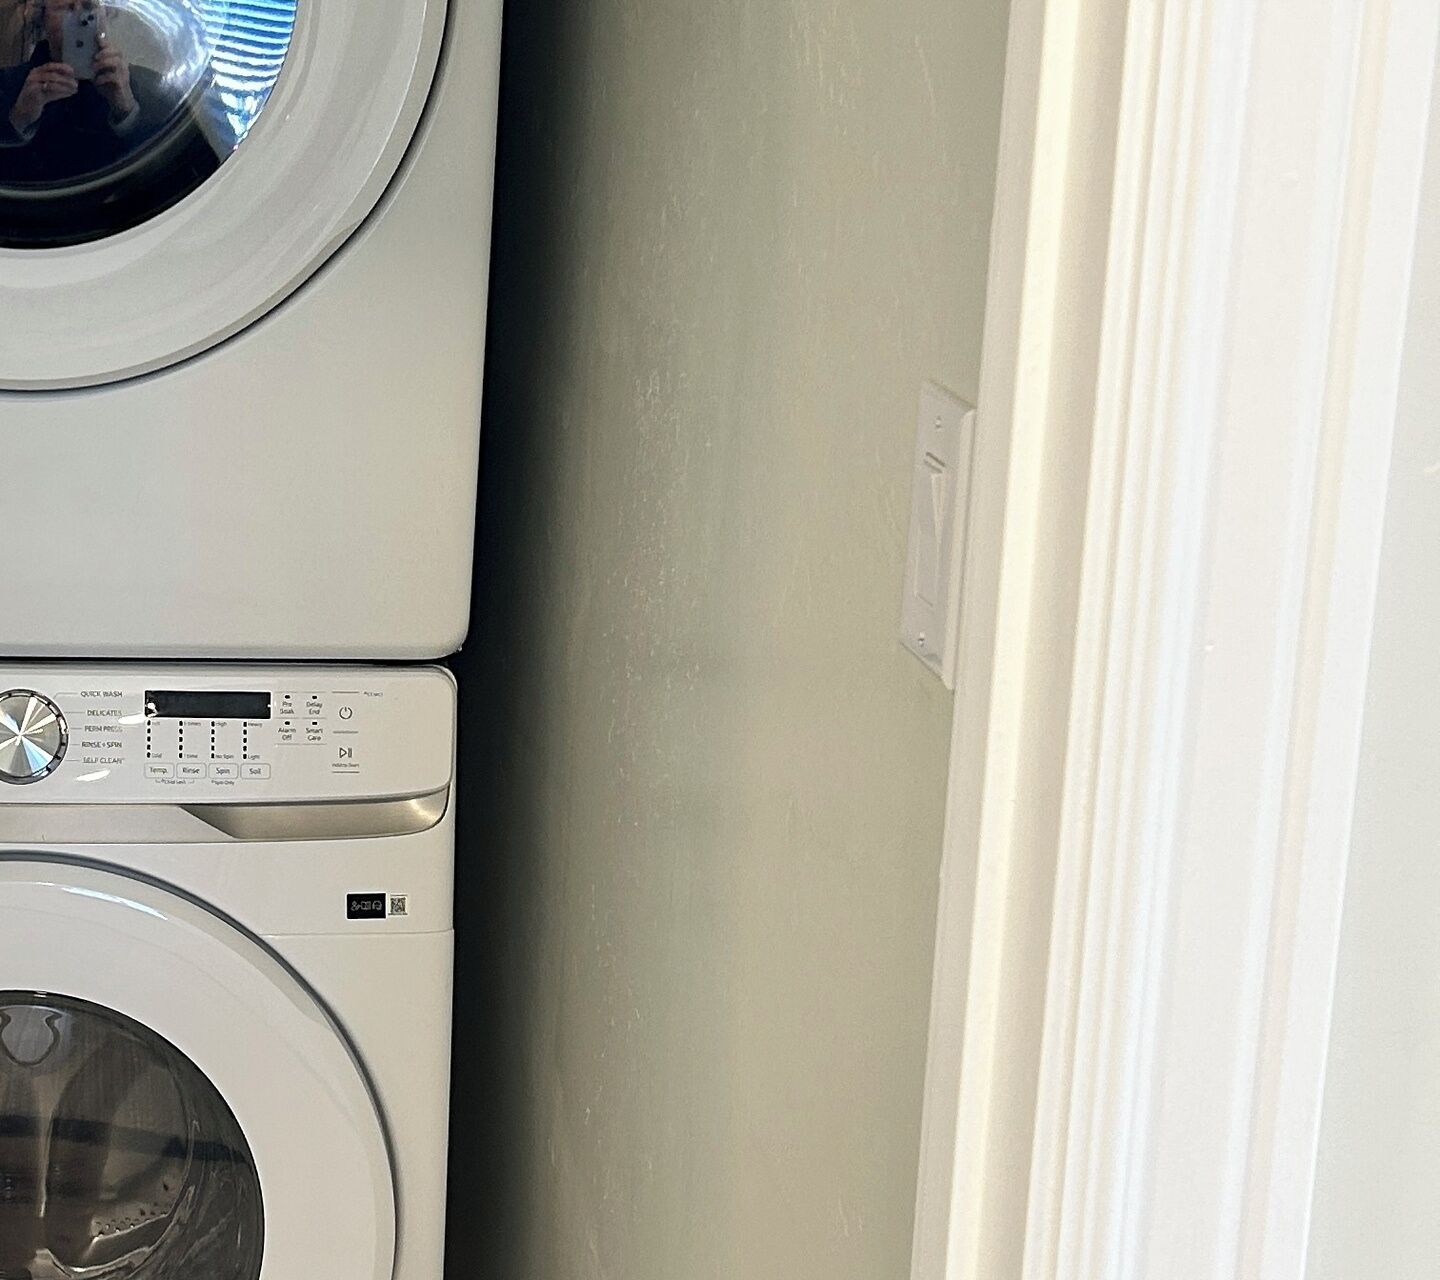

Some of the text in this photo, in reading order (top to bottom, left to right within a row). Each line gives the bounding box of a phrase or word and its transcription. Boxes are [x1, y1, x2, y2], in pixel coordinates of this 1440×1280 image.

[182, 767, 200, 775] Rinse
[216, 767, 231, 776] Spin
[249, 767, 262, 776] Soil
